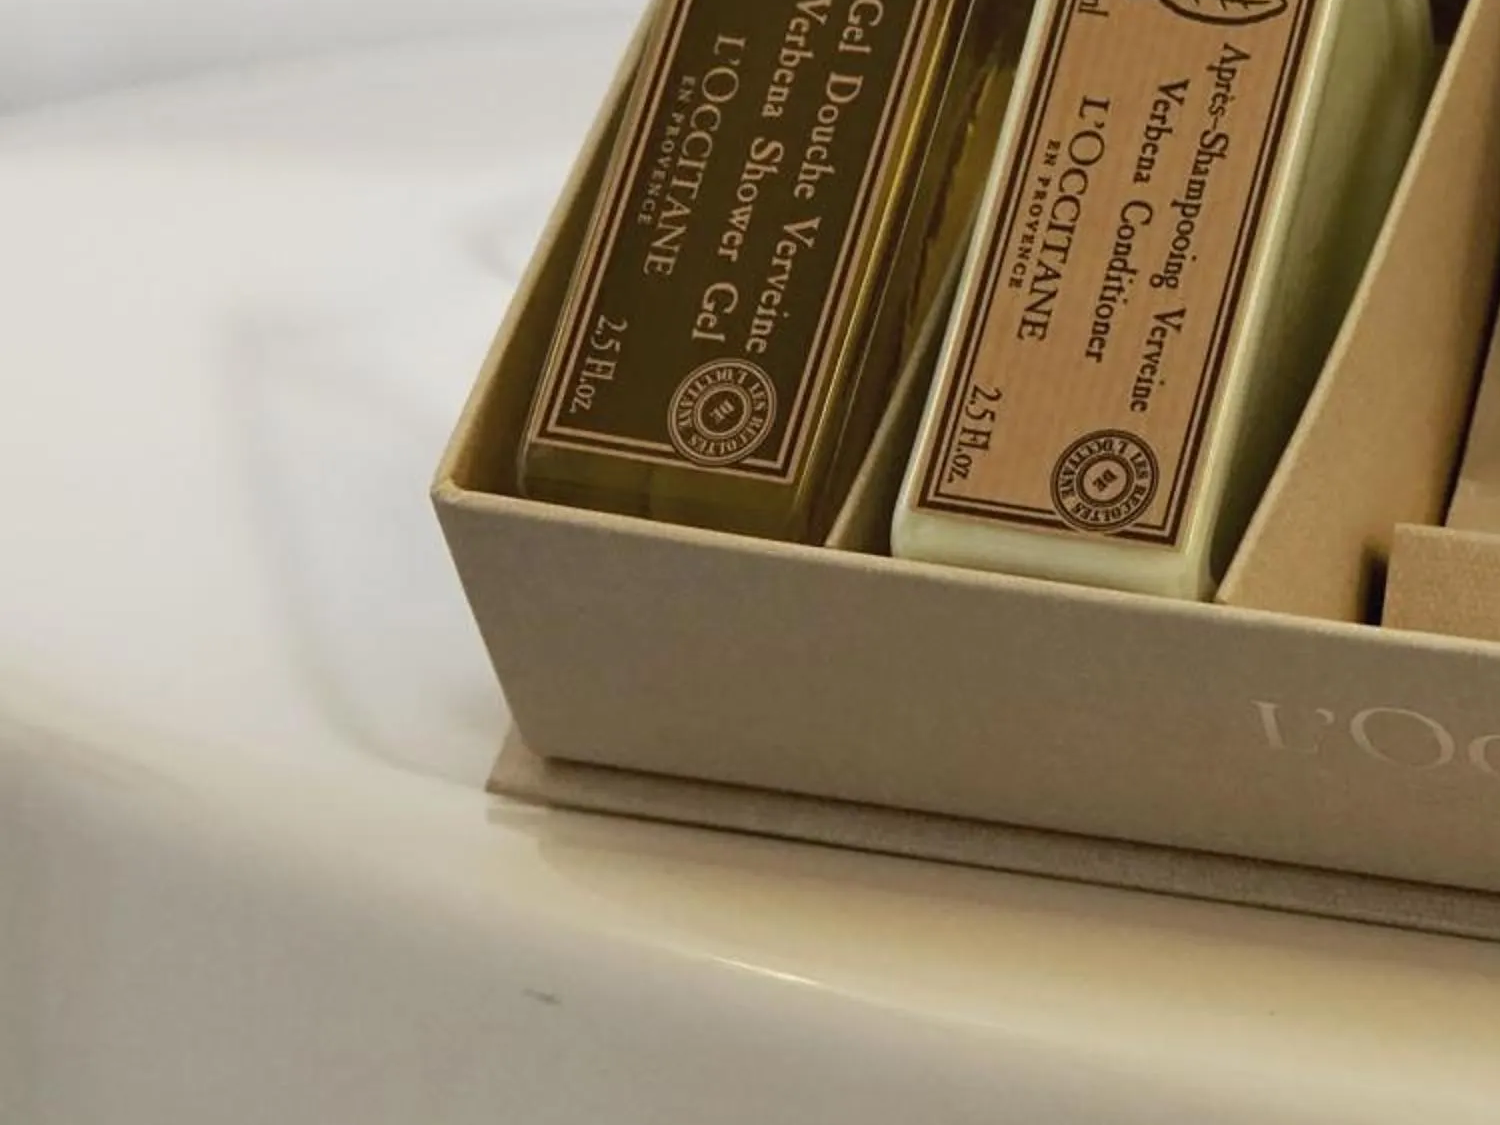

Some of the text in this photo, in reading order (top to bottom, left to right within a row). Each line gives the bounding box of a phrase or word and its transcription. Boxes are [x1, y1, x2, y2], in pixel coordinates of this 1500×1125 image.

[637, 75, 696, 225] EN PROVENCE
[717, 137, 785, 262] Shower
[793, 71, 864, 200] Douche
[745, 217, 822, 354] Verveine
[1009, 139, 1061, 289] EN PROVENCE
[1085, 78, 1191, 363] Verbena Conditioner
[1130, 42, 1251, 413] Après-Shampooing Verveine
[692, 282, 739, 342] Gel
